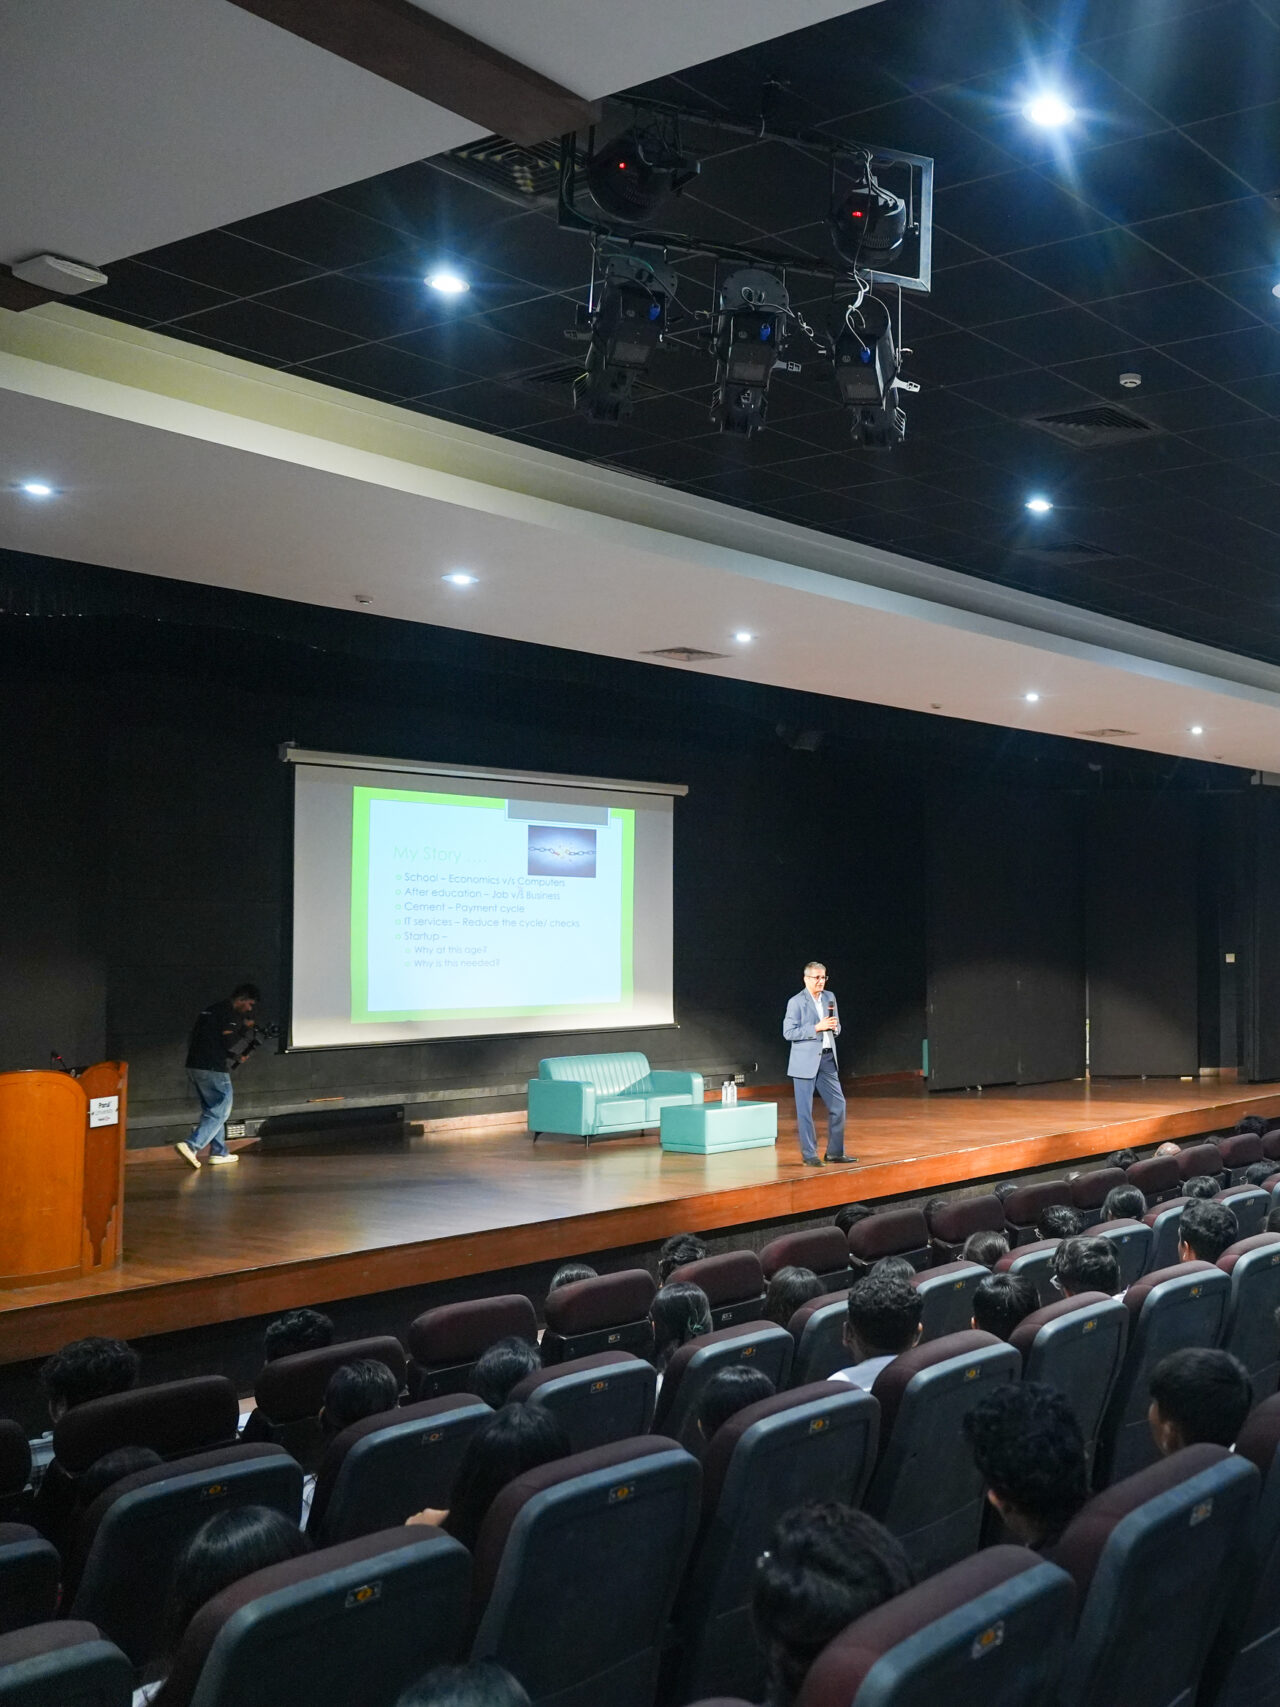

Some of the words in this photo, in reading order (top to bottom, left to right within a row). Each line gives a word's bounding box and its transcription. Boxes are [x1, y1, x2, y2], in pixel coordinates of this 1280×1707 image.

[394, 846, 418, 862] My
[424, 846, 462, 864] Story
[404, 872, 438, 882] School
[448, 874, 500, 884] Economics
[518, 876, 566, 888] Computers
[404, 888, 428, 898] After
[432, 888, 482, 898] education
[492, 890, 508, 900] Job
[526, 890, 560, 900] Business
[404, 902, 446, 912] Cement
[456, 902, 498, 912] Payment
[500, 904, 526, 914] cycle
[404, 918, 410, 926] IT
[414, 918, 454, 926] services
[462, 918, 500, 928] Reduce
[502, 918, 518, 928] the
[550, 920, 580, 928] checks
[404, 932, 440, 942] Startup
[414, 946, 434, 956] Why
[414, 960, 434, 968] Why
[460, 958, 500, 968] needed?
